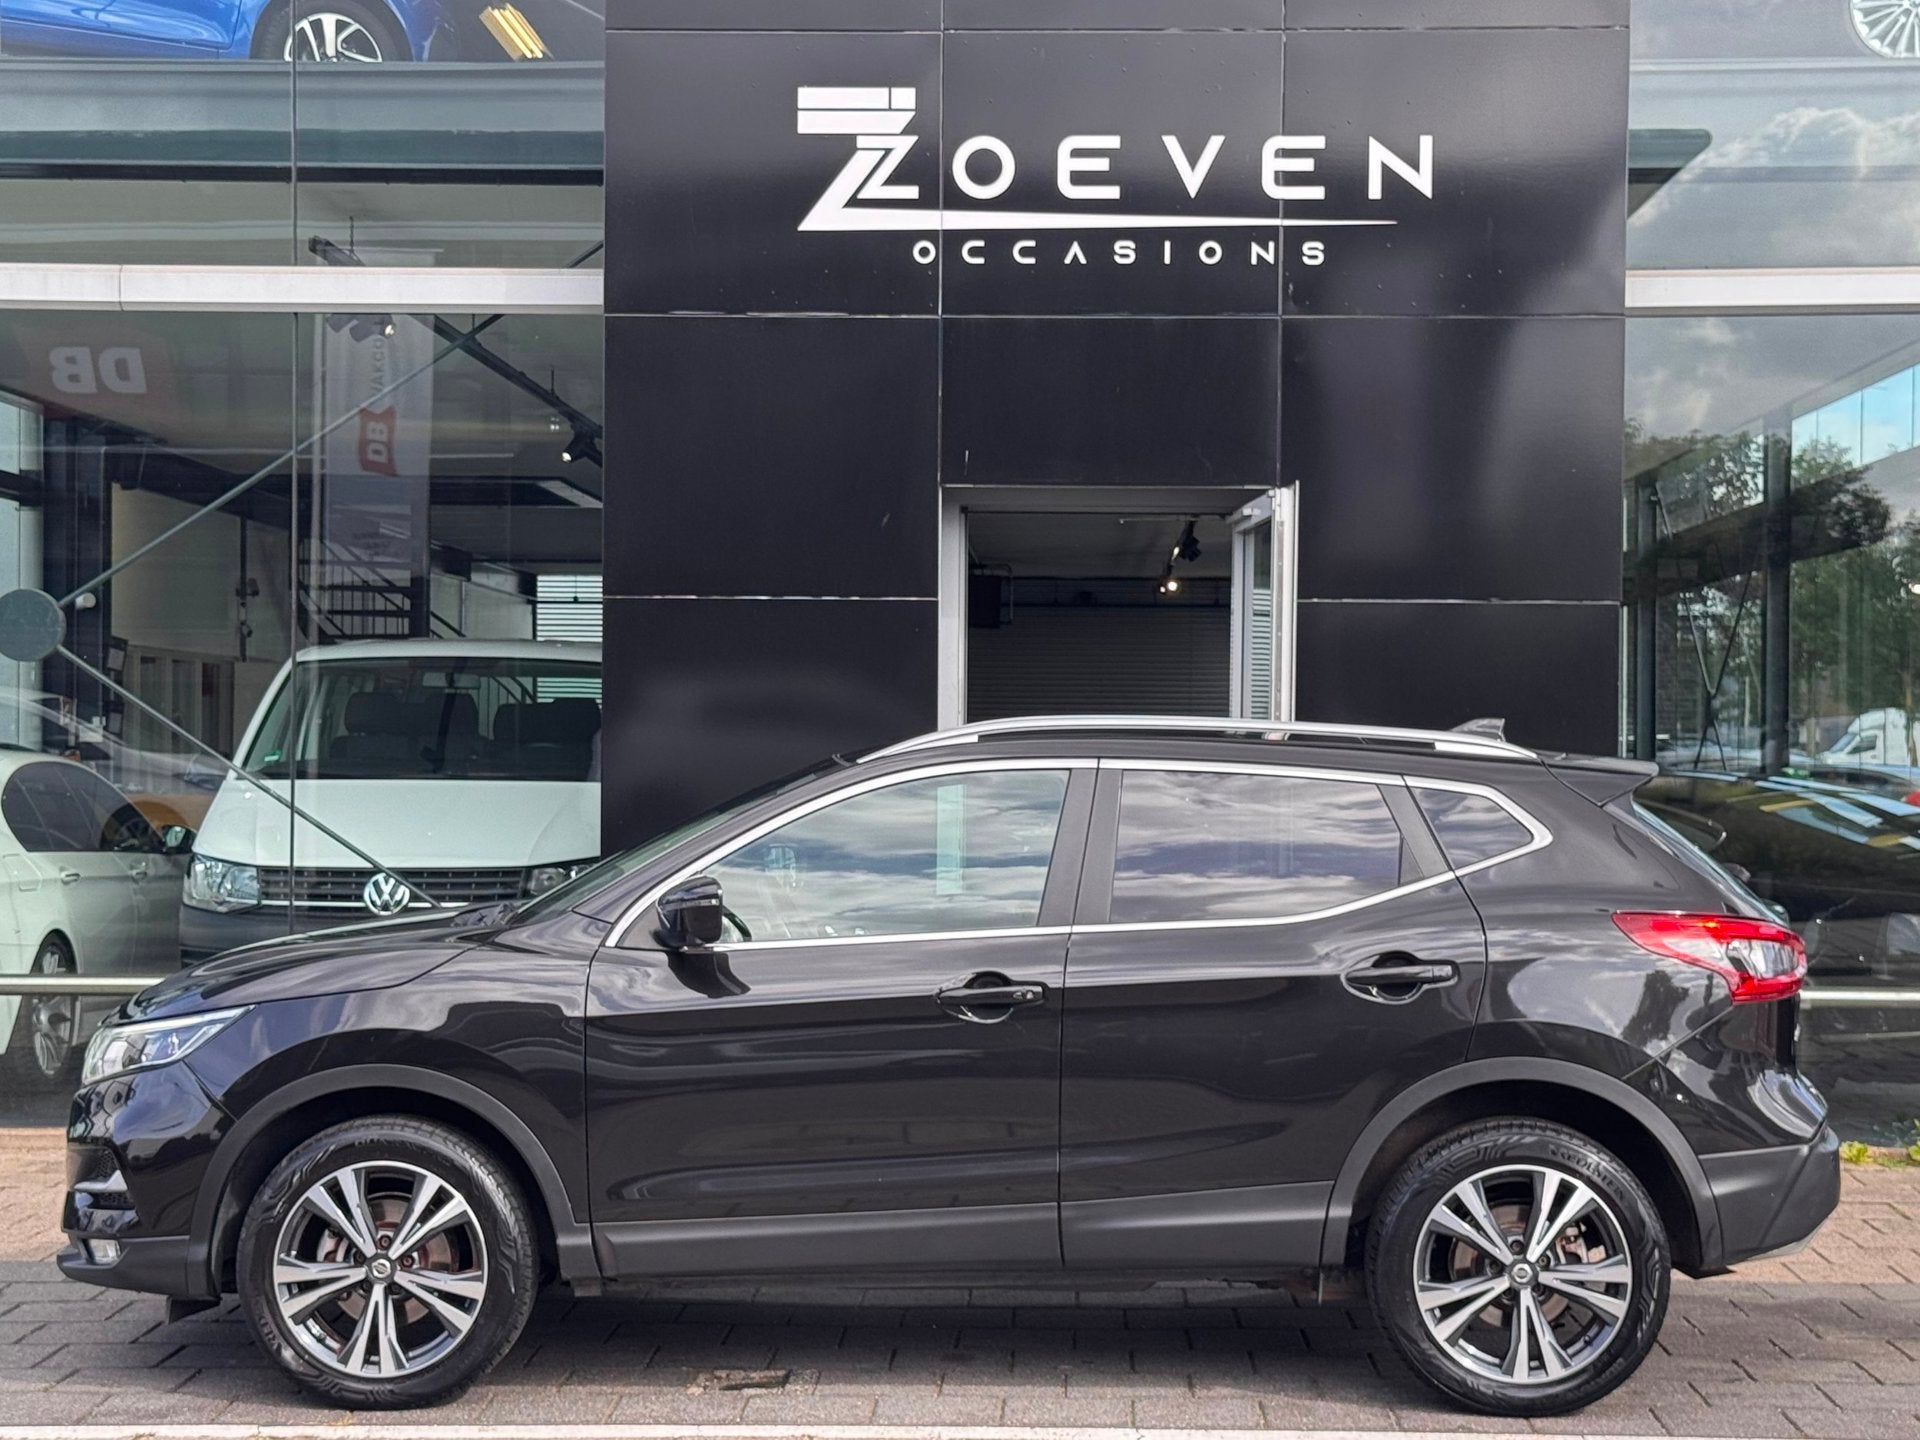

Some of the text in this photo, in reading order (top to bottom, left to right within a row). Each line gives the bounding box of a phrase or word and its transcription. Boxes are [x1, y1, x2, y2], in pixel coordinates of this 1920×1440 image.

[798, 88, 1433, 202] ZOEVEN
[912, 240, 1325, 265] OCCASIONS
[366, 421, 389, 464] DB
[363, 872, 410, 916] VW
